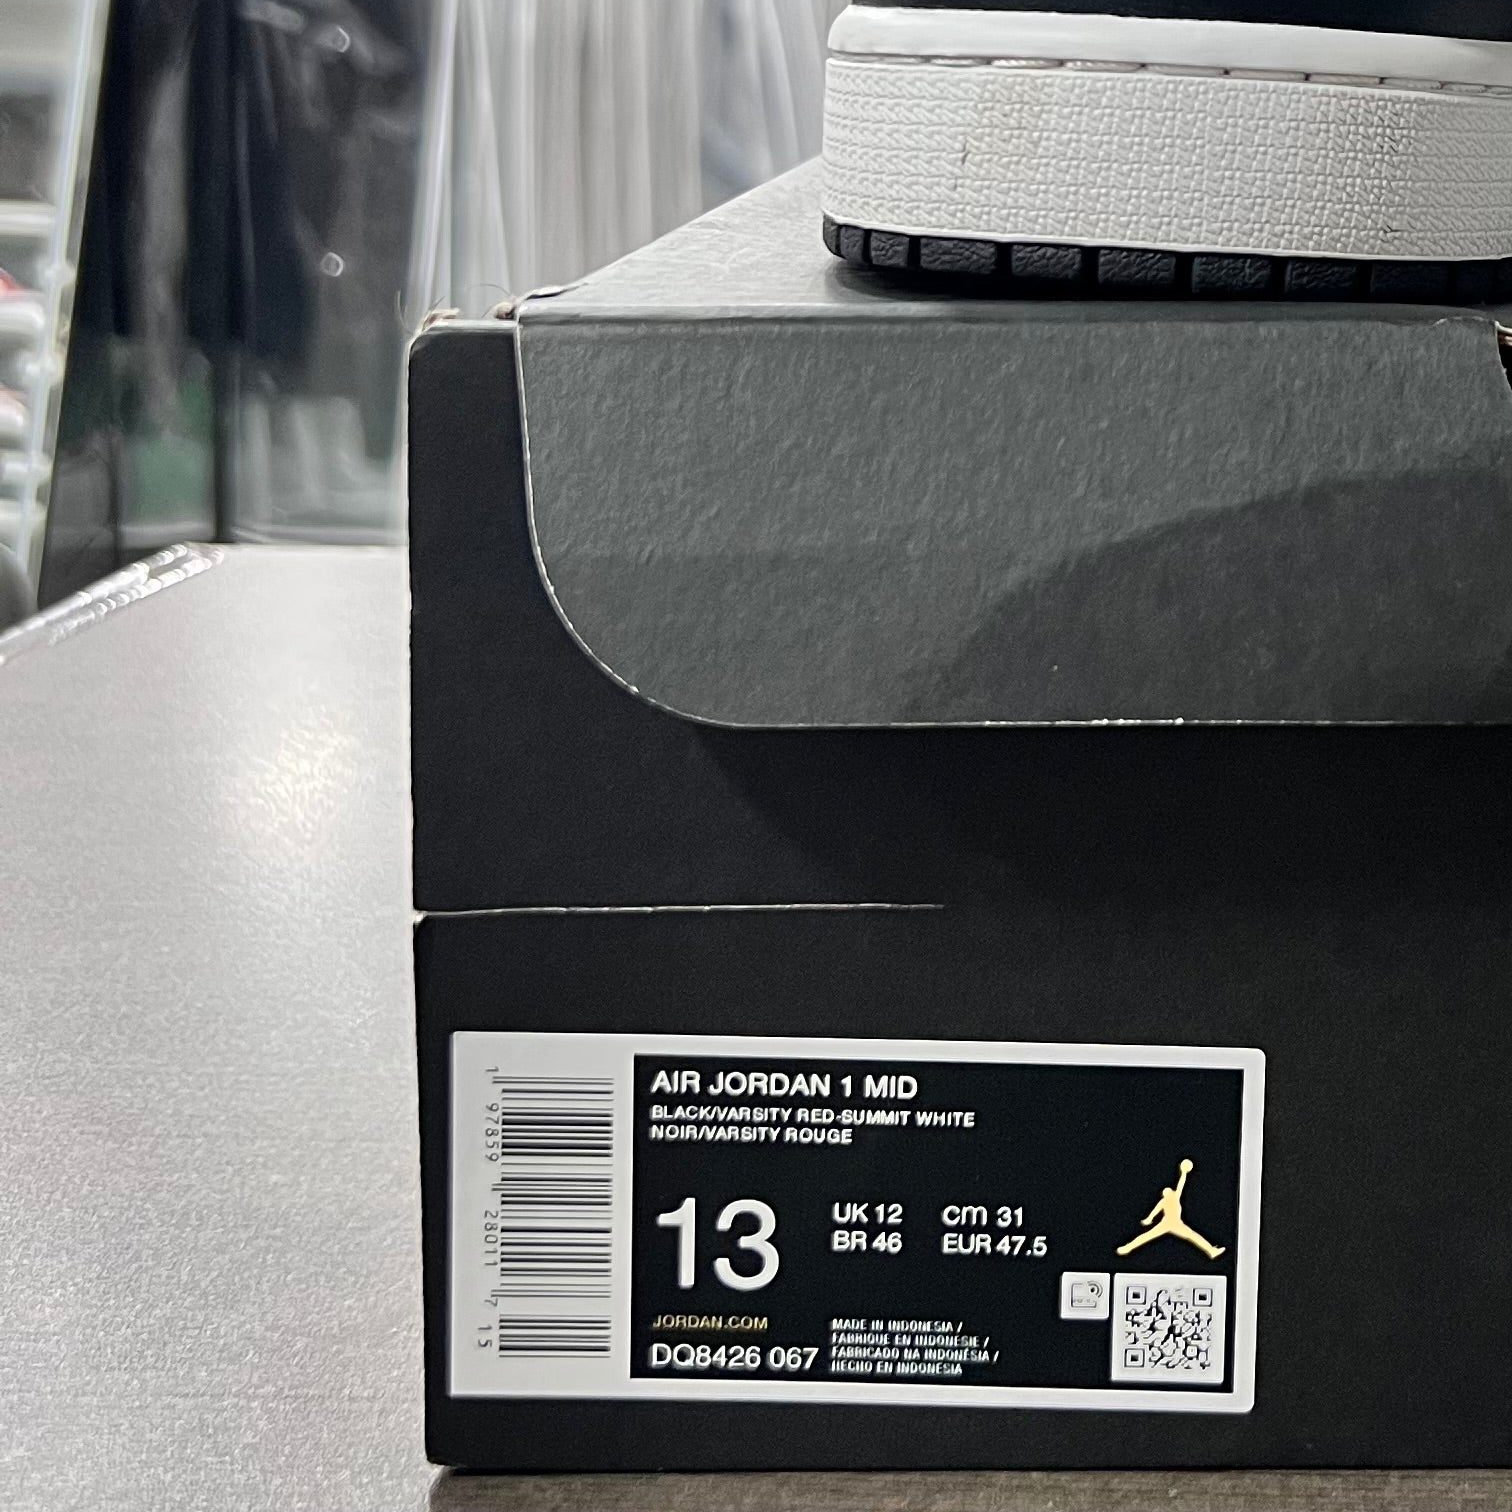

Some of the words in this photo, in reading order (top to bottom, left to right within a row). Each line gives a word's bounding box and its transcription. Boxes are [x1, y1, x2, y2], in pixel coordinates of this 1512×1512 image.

[651, 1070, 701, 1095] AIR
[708, 1072, 831, 1097] JORDAN
[840, 1075, 852, 1098] 1
[864, 1075, 918, 1099] MID
[651, 1105, 792, 1123] BLACK/VARSITY
[796, 1108, 911, 1126] RED-SUMMIT
[915, 1111, 975, 1128] WHITE
[485, 1102, 500, 1162] 97859
[651, 1125, 781, 1142] NOIR/VARSITY
[784, 1127, 853, 1144] ROUGE
[832, 1202, 869, 1224] UK
[876, 1203, 903, 1225] 12
[997, 1206, 1024, 1228] 31
[484, 1210, 499, 1267] 28011
[656, 1197, 780, 1291] 13
[832, 1230, 867, 1252] BR
[872, 1231, 903, 1254] 46
[942, 1233, 991, 1255] EUR
[996, 1235, 1048, 1257] 47.5
[653, 1315, 768, 1329] JORDAN.COM
[832, 1319, 867, 1330] MADE
[872, 1320, 884, 1331] IN
[888, 1320, 953, 1332] INDONESIA
[832, 1333, 890, 1345] FABRIQUE
[895, 1335, 911, 1345] EN
[652, 1343, 761, 1369] DQ8426
[769, 1346, 819, 1370] 067
[832, 1346, 899, 1359] FABRICADO
[832, 1361, 872, 1373] HECHO
[877, 1362, 892, 1373] EN
